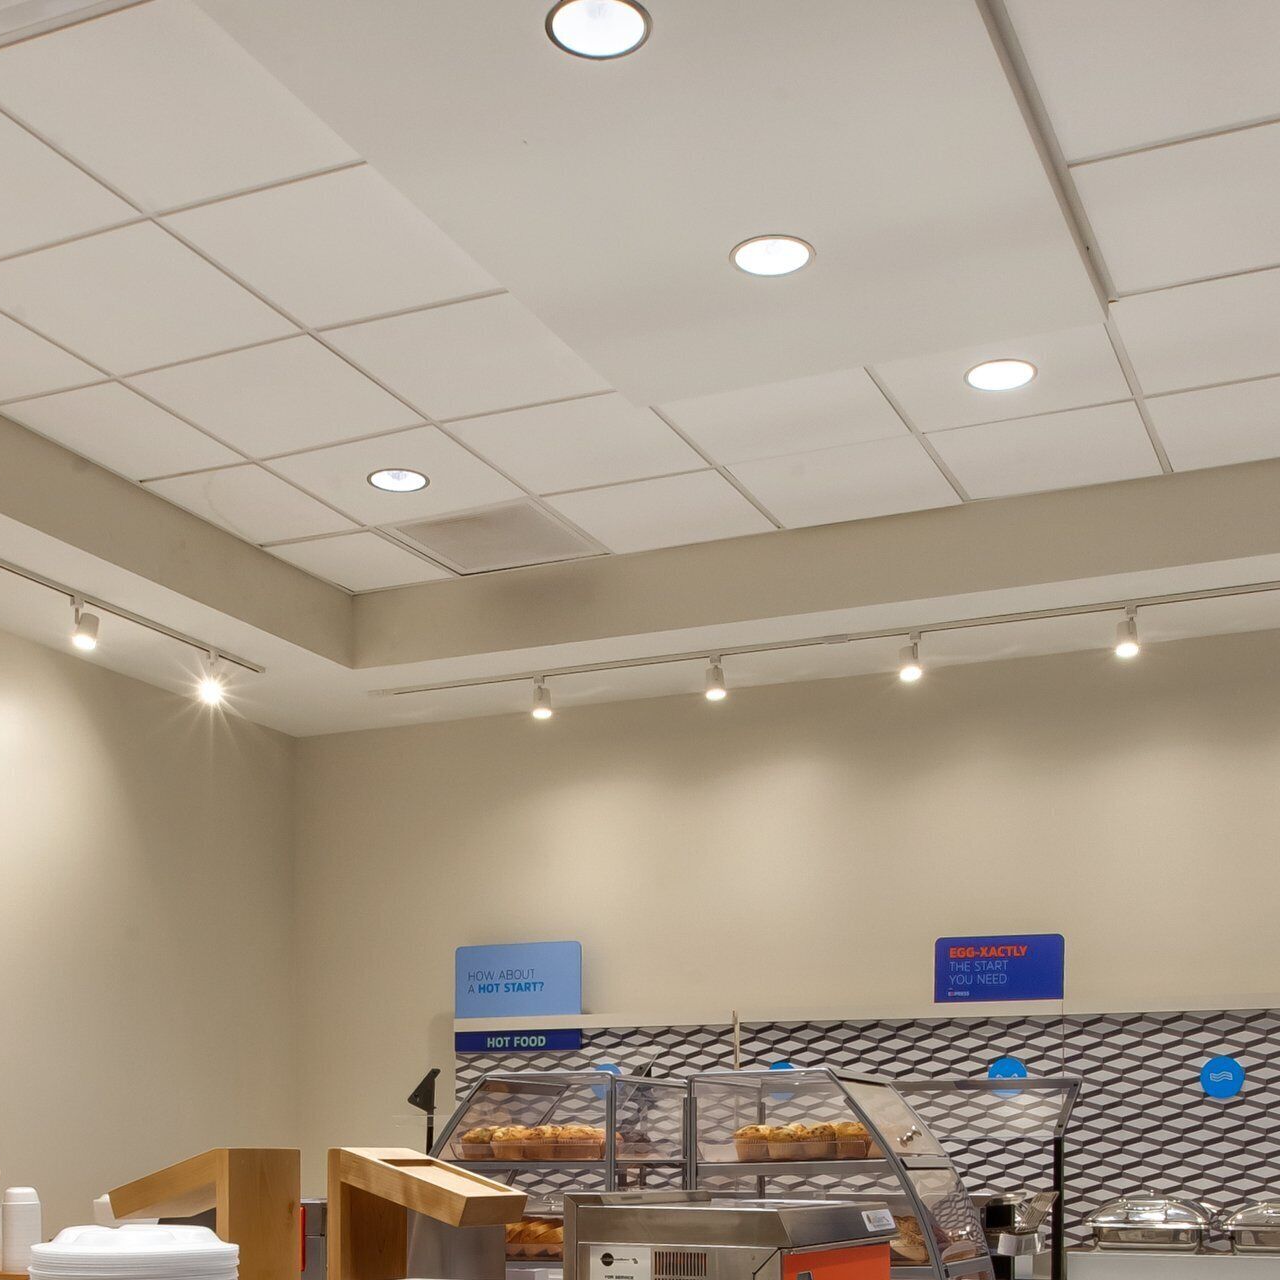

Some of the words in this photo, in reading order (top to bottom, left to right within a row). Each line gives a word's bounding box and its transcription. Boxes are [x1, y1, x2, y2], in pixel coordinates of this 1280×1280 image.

[949, 945, 1028, 958] EGG-XACTLY
[950, 961, 971, 972] THE
[974, 960, 1009, 972] START
[467, 971, 495, 982] HOW
[498, 968, 536, 981] ABOUT
[949, 974, 973, 985] YOU
[977, 973, 1008, 984] NEED
[467, 984, 475, 995] A
[478, 983, 501, 994] HOT
[504, 981, 545, 993] START?
[487, 1037, 511, 1048] HOT
[514, 1036, 546, 1048] FOOD
